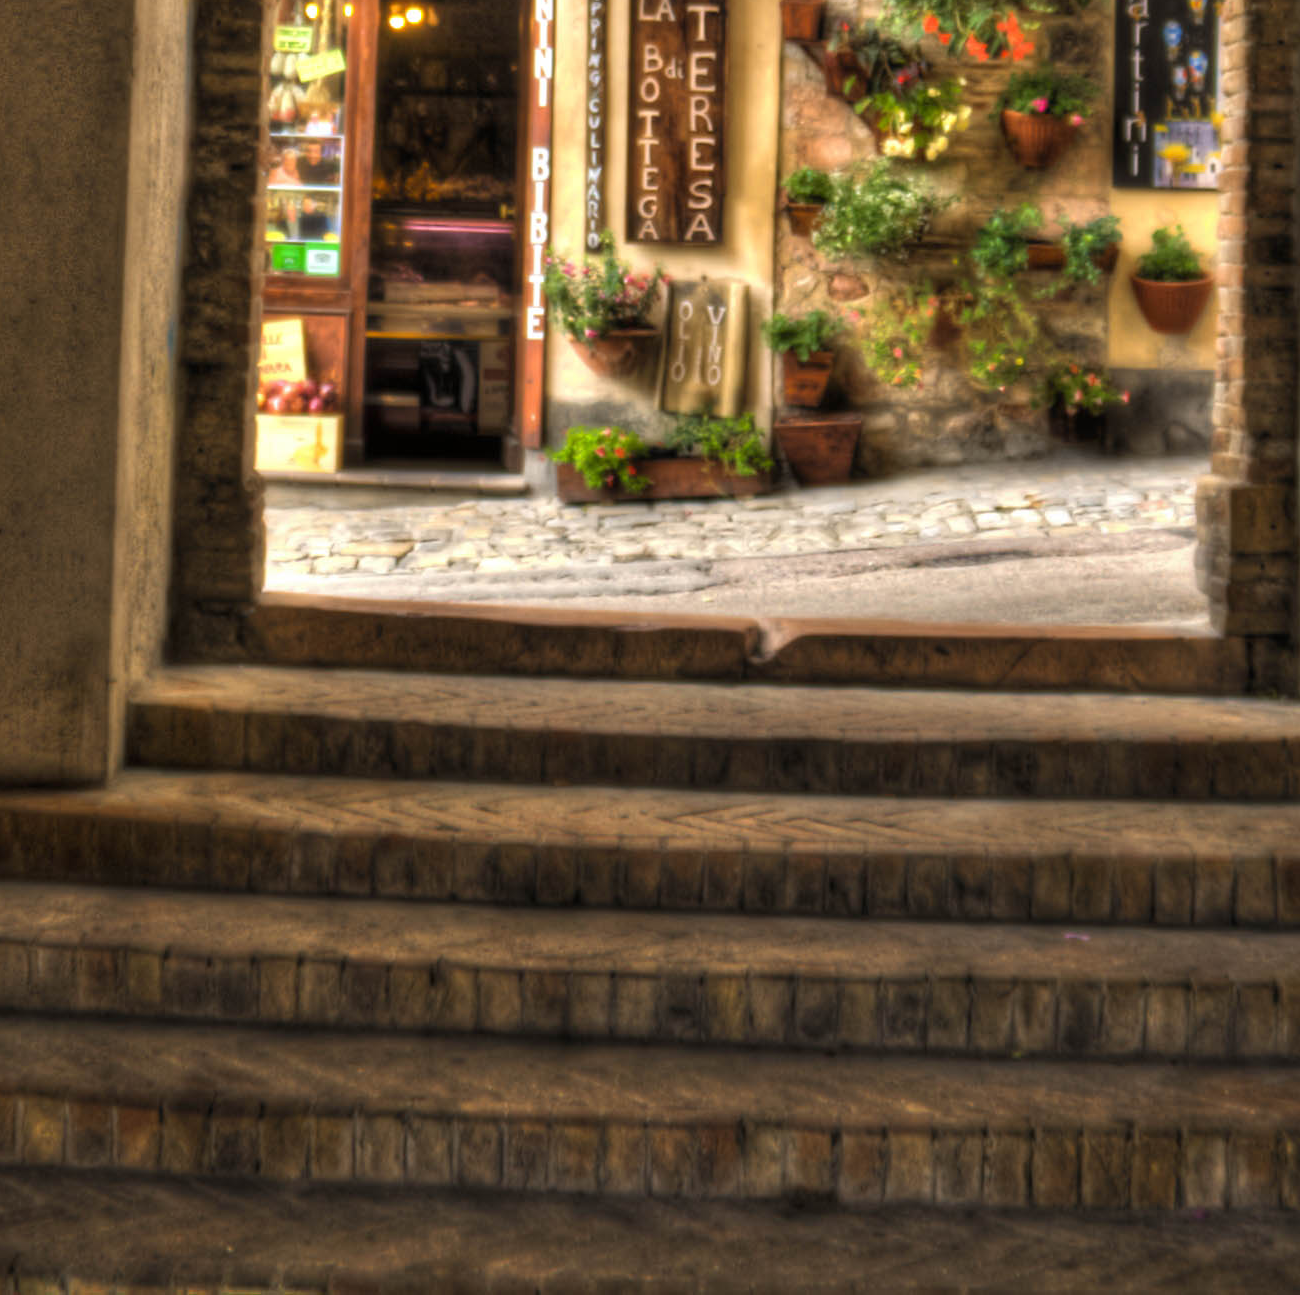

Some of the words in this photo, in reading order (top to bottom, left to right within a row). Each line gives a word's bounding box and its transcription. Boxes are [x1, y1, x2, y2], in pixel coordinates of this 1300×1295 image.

[637, 43, 664, 241] BOTTEGA
[664, 58, 685, 80] di
[685, 4, 719, 241] TERESA
[527, 146, 550, 340] BIBITE
[586, 96, 602, 249] CULINARIO
[671, 300, 694, 383] OLIO
[707, 305, 726, 387] VINO
